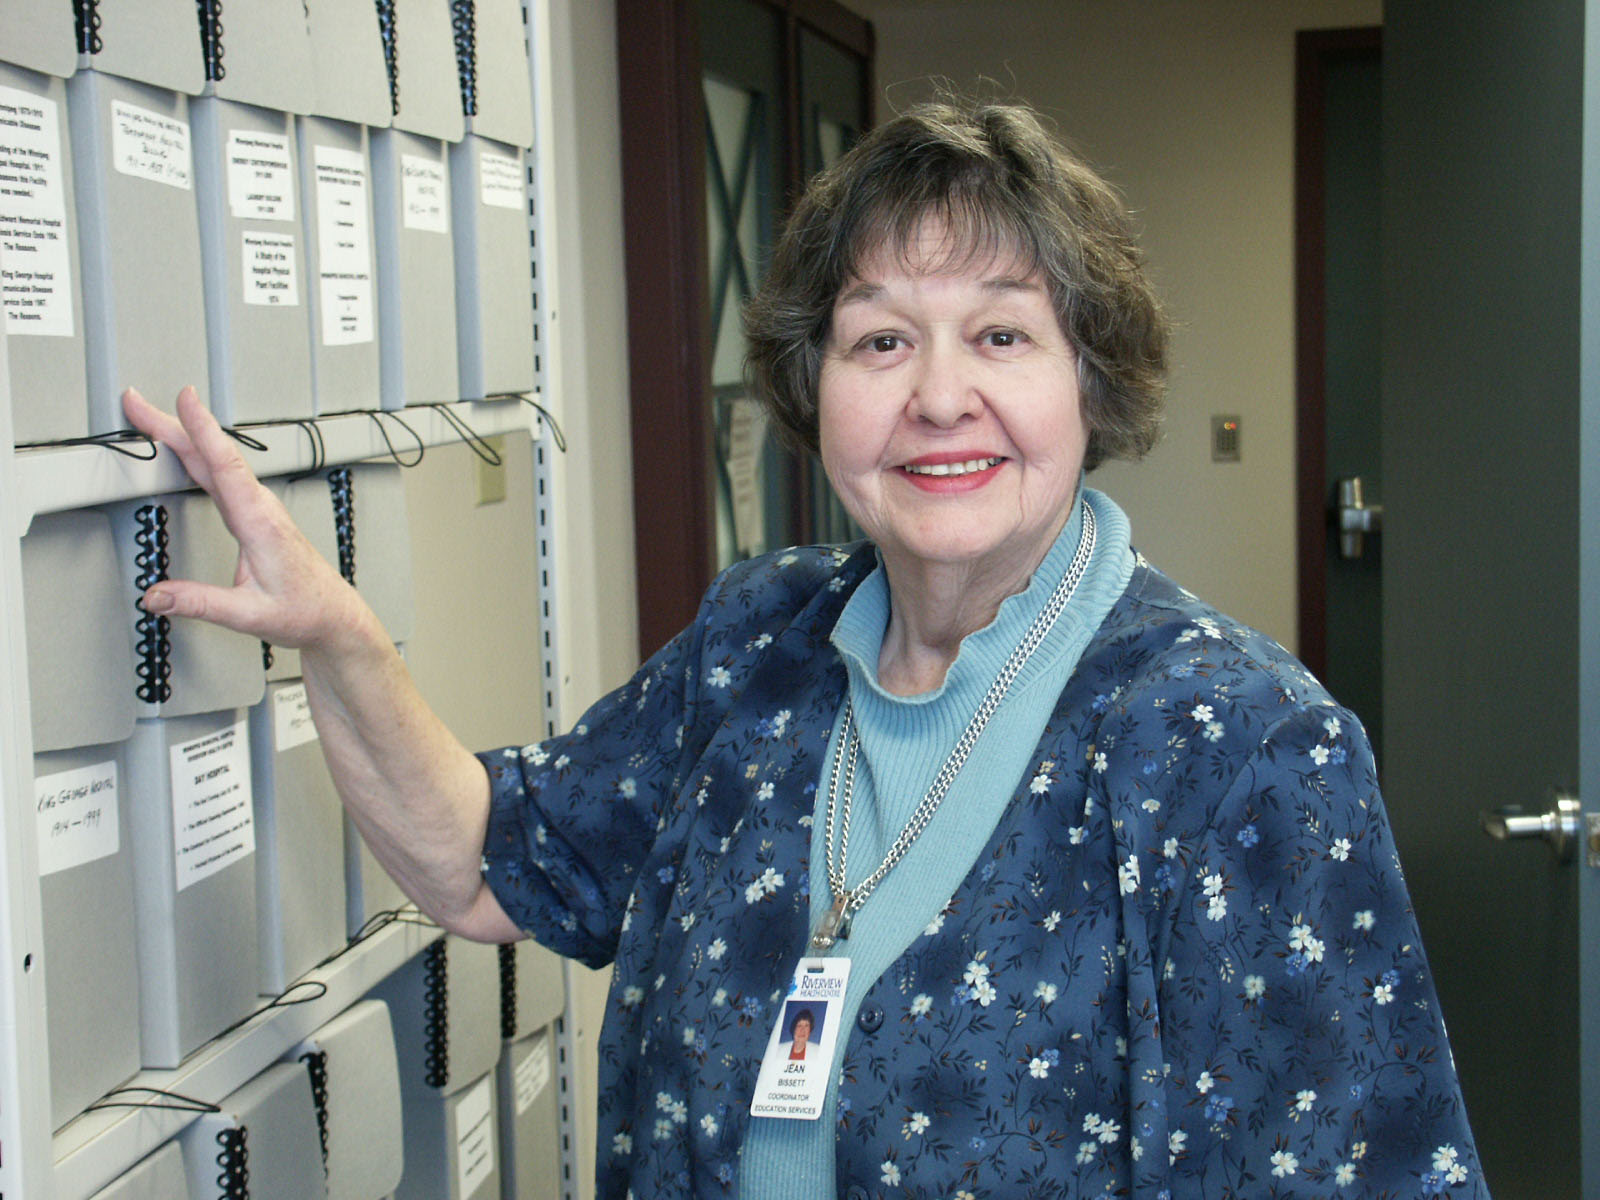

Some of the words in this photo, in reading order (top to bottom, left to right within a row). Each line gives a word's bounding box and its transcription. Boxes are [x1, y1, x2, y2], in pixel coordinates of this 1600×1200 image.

[206, 764, 230, 780] HOSPITAL
[784, 1064, 806, 1074] JEAN
[777, 1078, 806, 1087] BISSETT
[768, 1092, 809, 1102] COORDINATOR
[754, 1104, 787, 1113] EDUCATION
[788, 1106, 816, 1115] SERVICES
